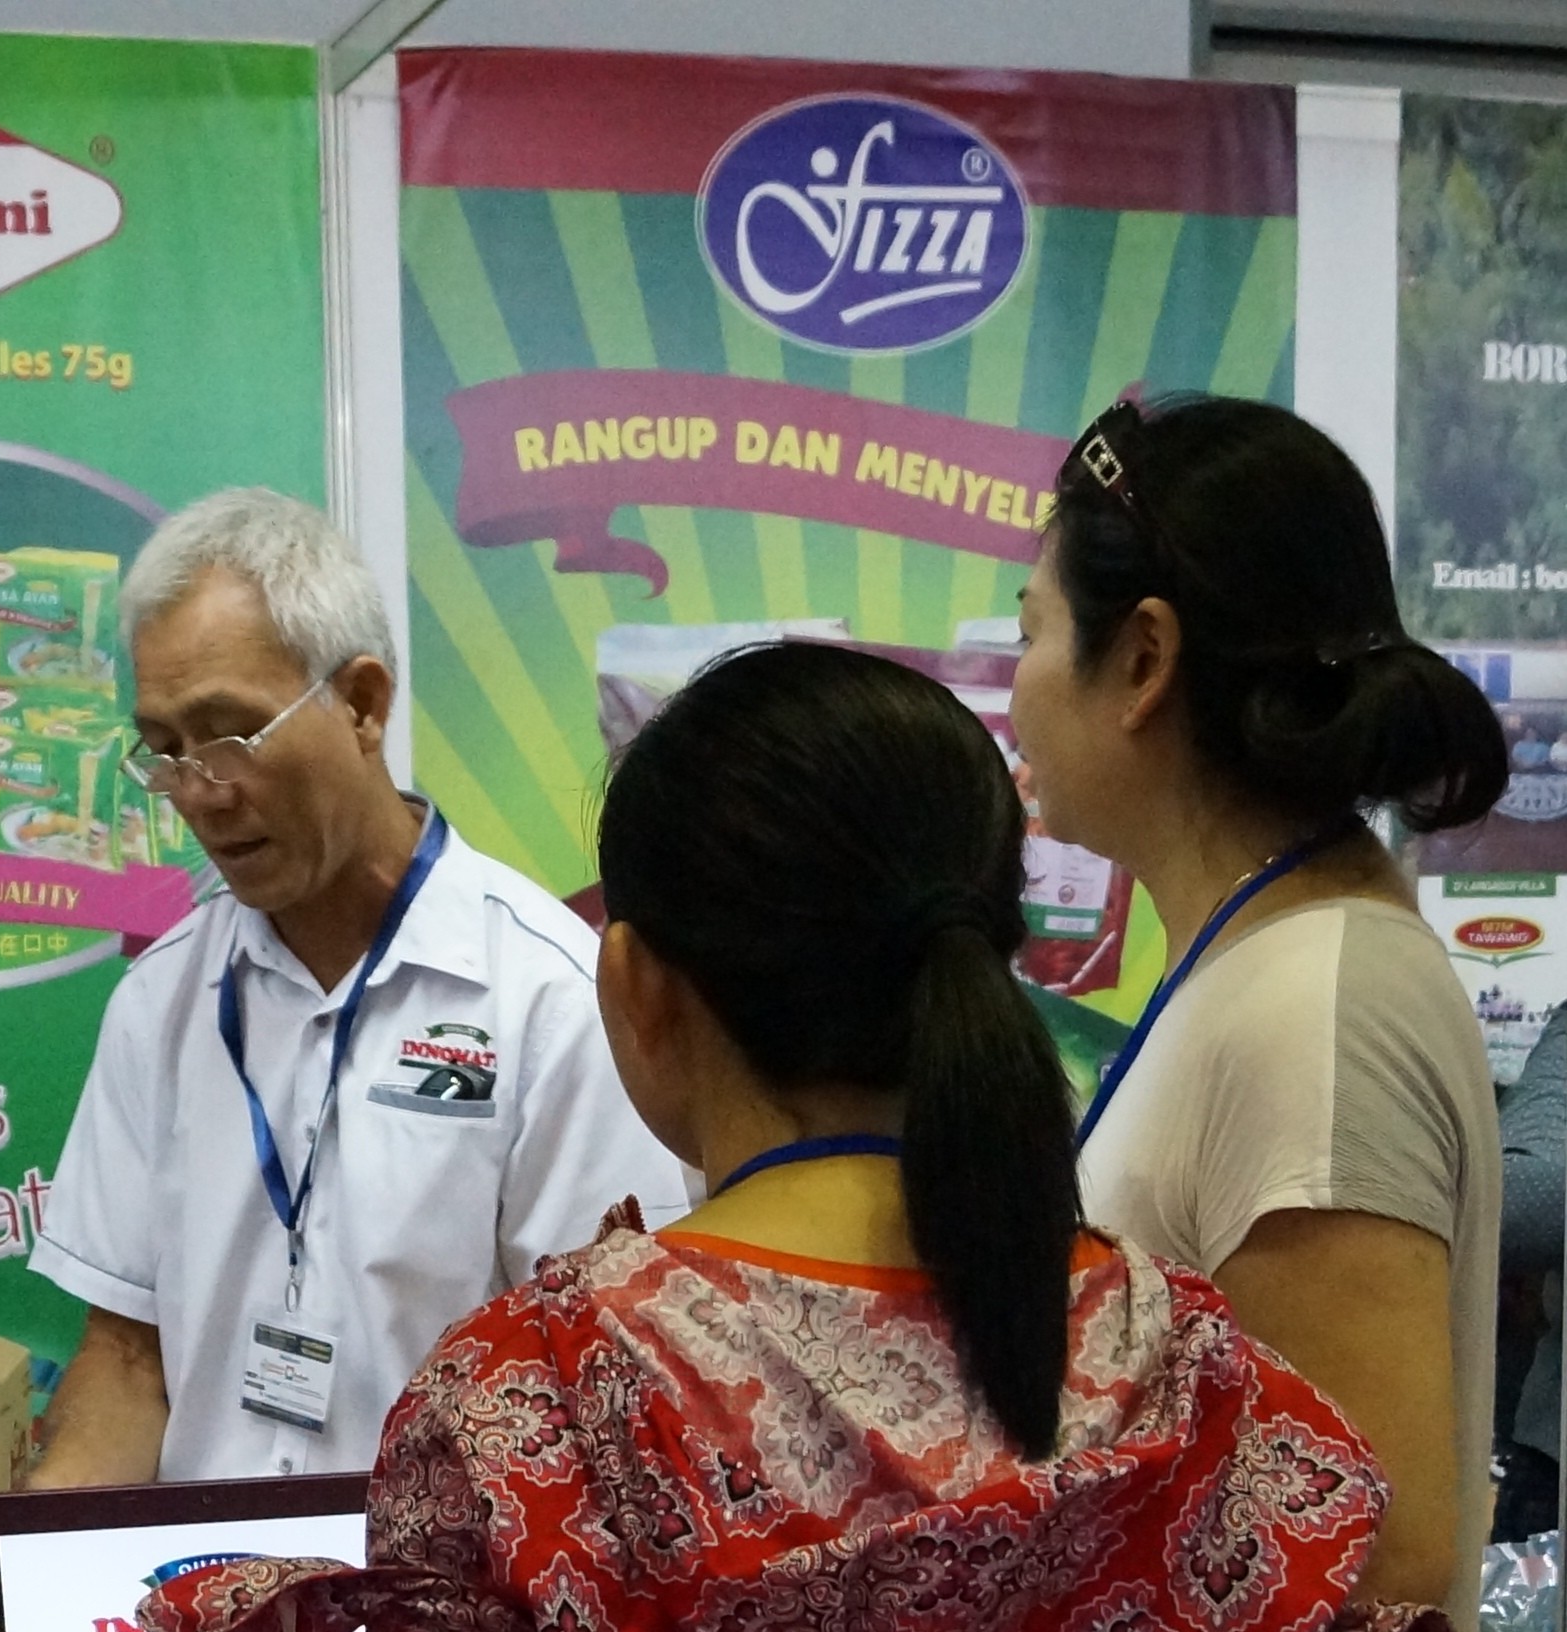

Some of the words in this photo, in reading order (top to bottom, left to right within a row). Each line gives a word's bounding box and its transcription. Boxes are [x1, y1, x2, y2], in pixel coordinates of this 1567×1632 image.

[61, 344, 132, 390] 75g
[514, 416, 718, 473] RANGUP
[735, 420, 841, 477] DAN
[1432, 561, 1518, 590] Email
